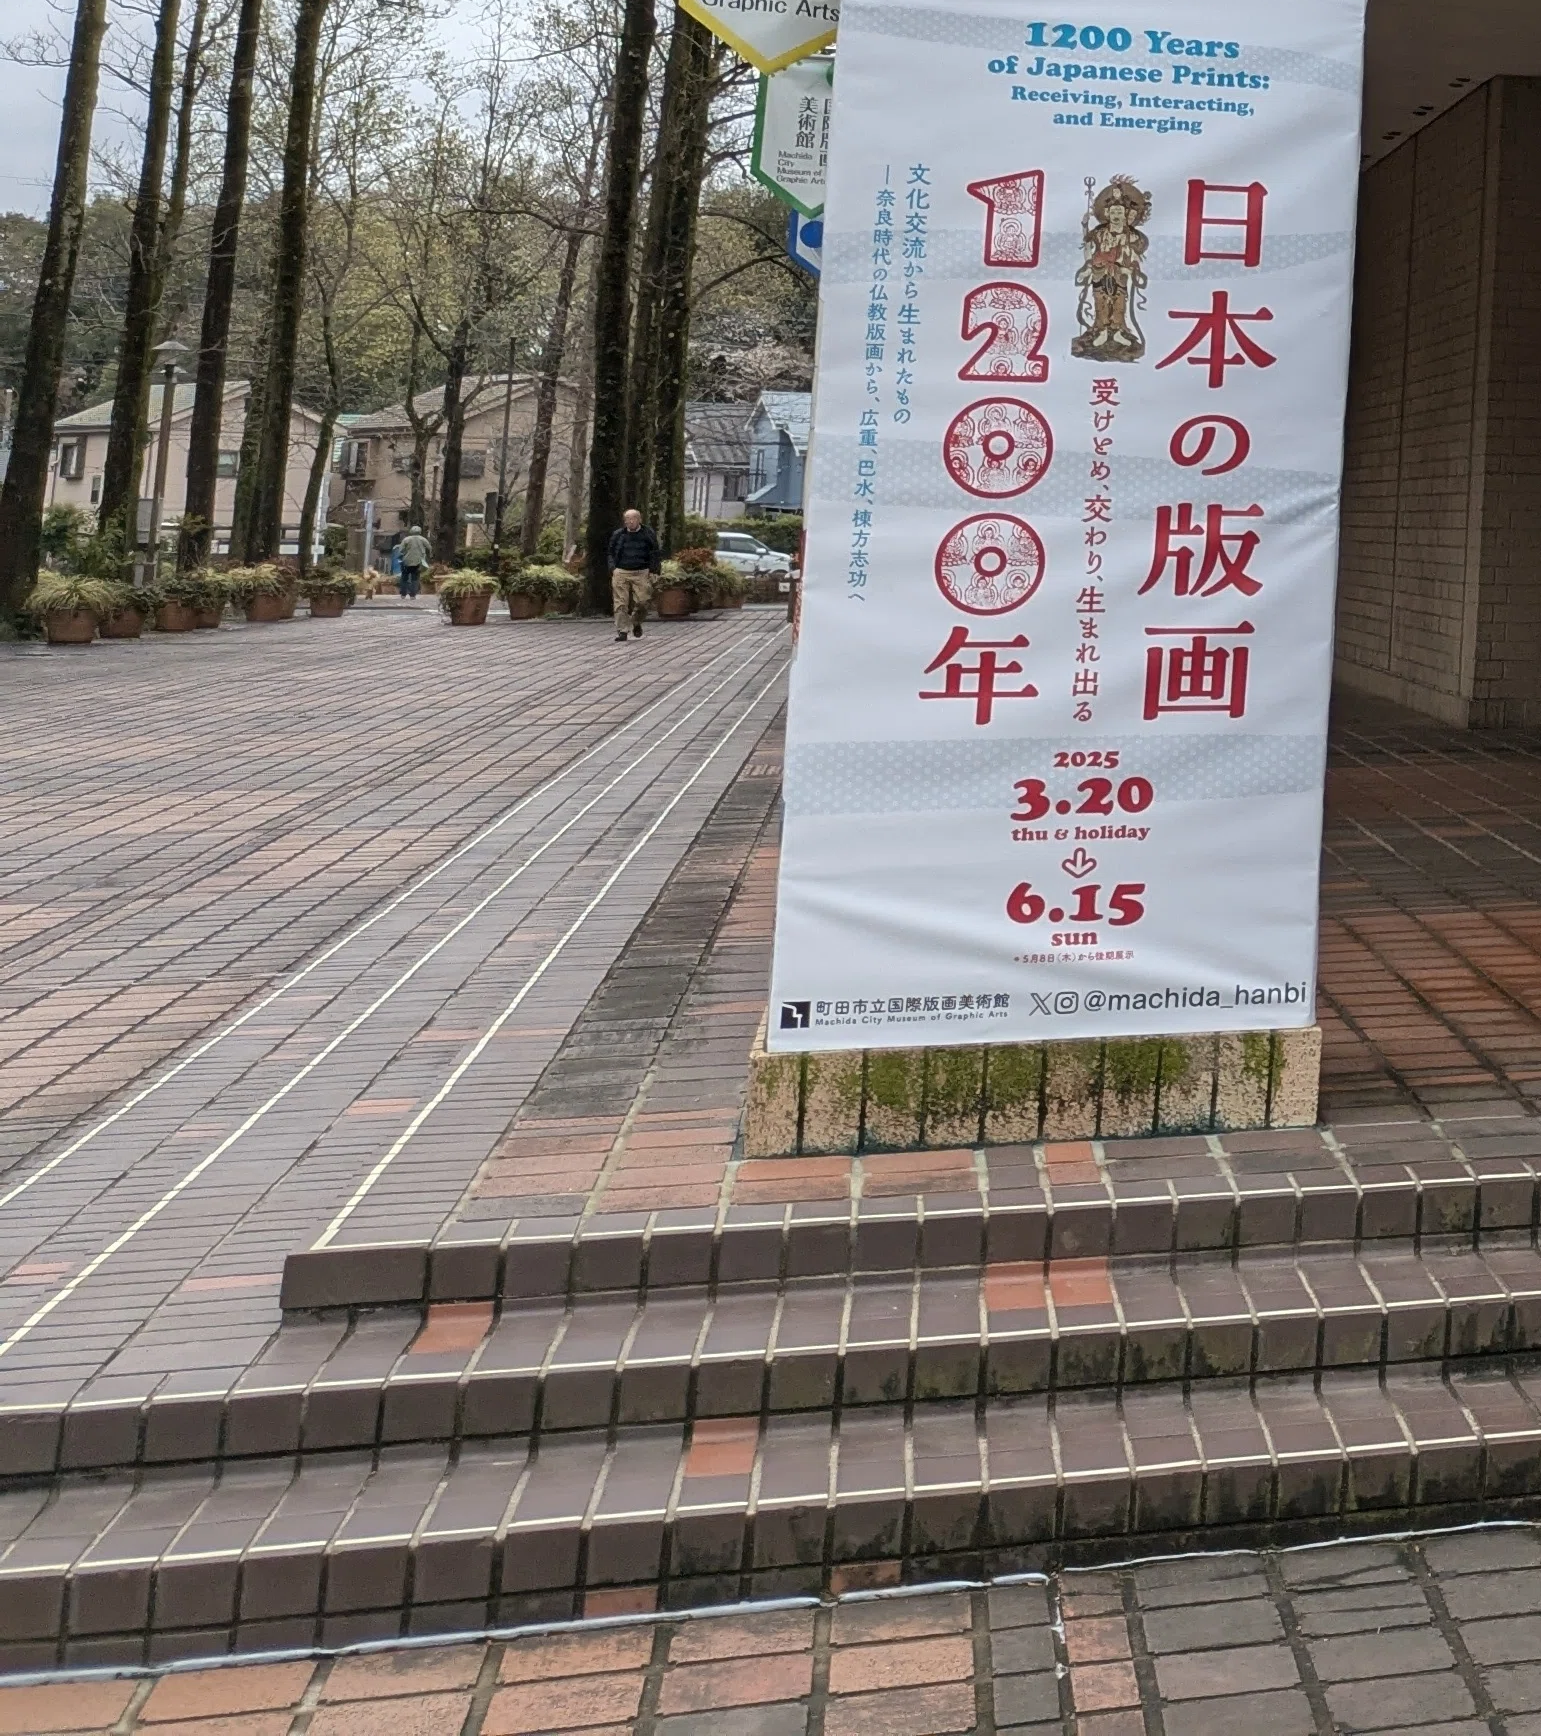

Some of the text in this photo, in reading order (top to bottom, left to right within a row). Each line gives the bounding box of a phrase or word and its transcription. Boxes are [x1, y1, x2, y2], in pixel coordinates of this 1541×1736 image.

[795, 0, 841, 23] Arts
[1024, 21, 1240, 59] 1200 Years
[987, 55, 1271, 90] of Japanese Prints:
[1010, 84, 1255, 117] Receiving, Interacting,
[794, 96, 819, 149] 美術館
[1052, 111, 1204, 136] and Emerging
[893, 163, 932, 425] 文化交流から生まれたもの
[918, 168, 1054, 725] 1200年
[1136, 178, 1278, 721] 日本の版画
[1071, 377, 1121, 723] 受けとめ、交わり、生まれ出る
[1053, 750, 1120, 769] 2025
[1010, 776, 1155, 822] 3.20
[1011, 825, 1151, 842] thu & holiday
[1006, 881, 1147, 926] 6.15
[1050, 931, 1099, 947] sun
[815, 992, 1011, 1016] 町田市立国際版画美術館
[1084, 981, 1308, 1012] @machida_hanbi
[815, 1009, 1009, 1027] Machida City Museum of Graphic Arts
